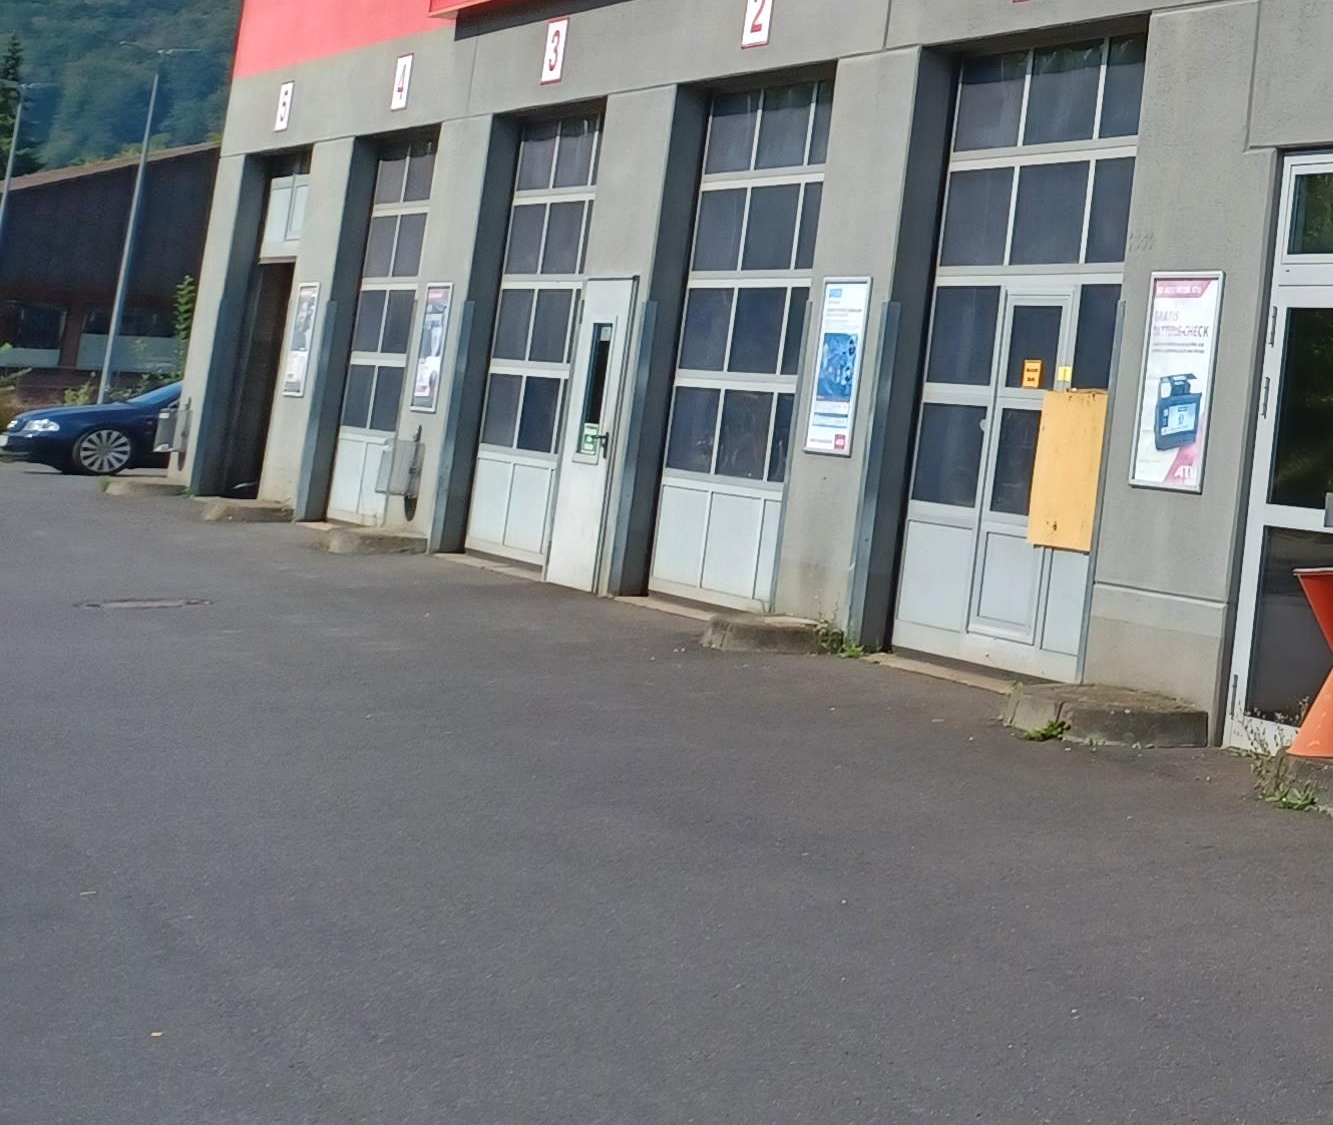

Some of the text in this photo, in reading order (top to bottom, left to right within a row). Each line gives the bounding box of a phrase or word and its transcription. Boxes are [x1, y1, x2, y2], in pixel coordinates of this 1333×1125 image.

[548, 30, 561, 71] 3
[396, 63, 407, 100] 4
[279, 89, 289, 122] 5
